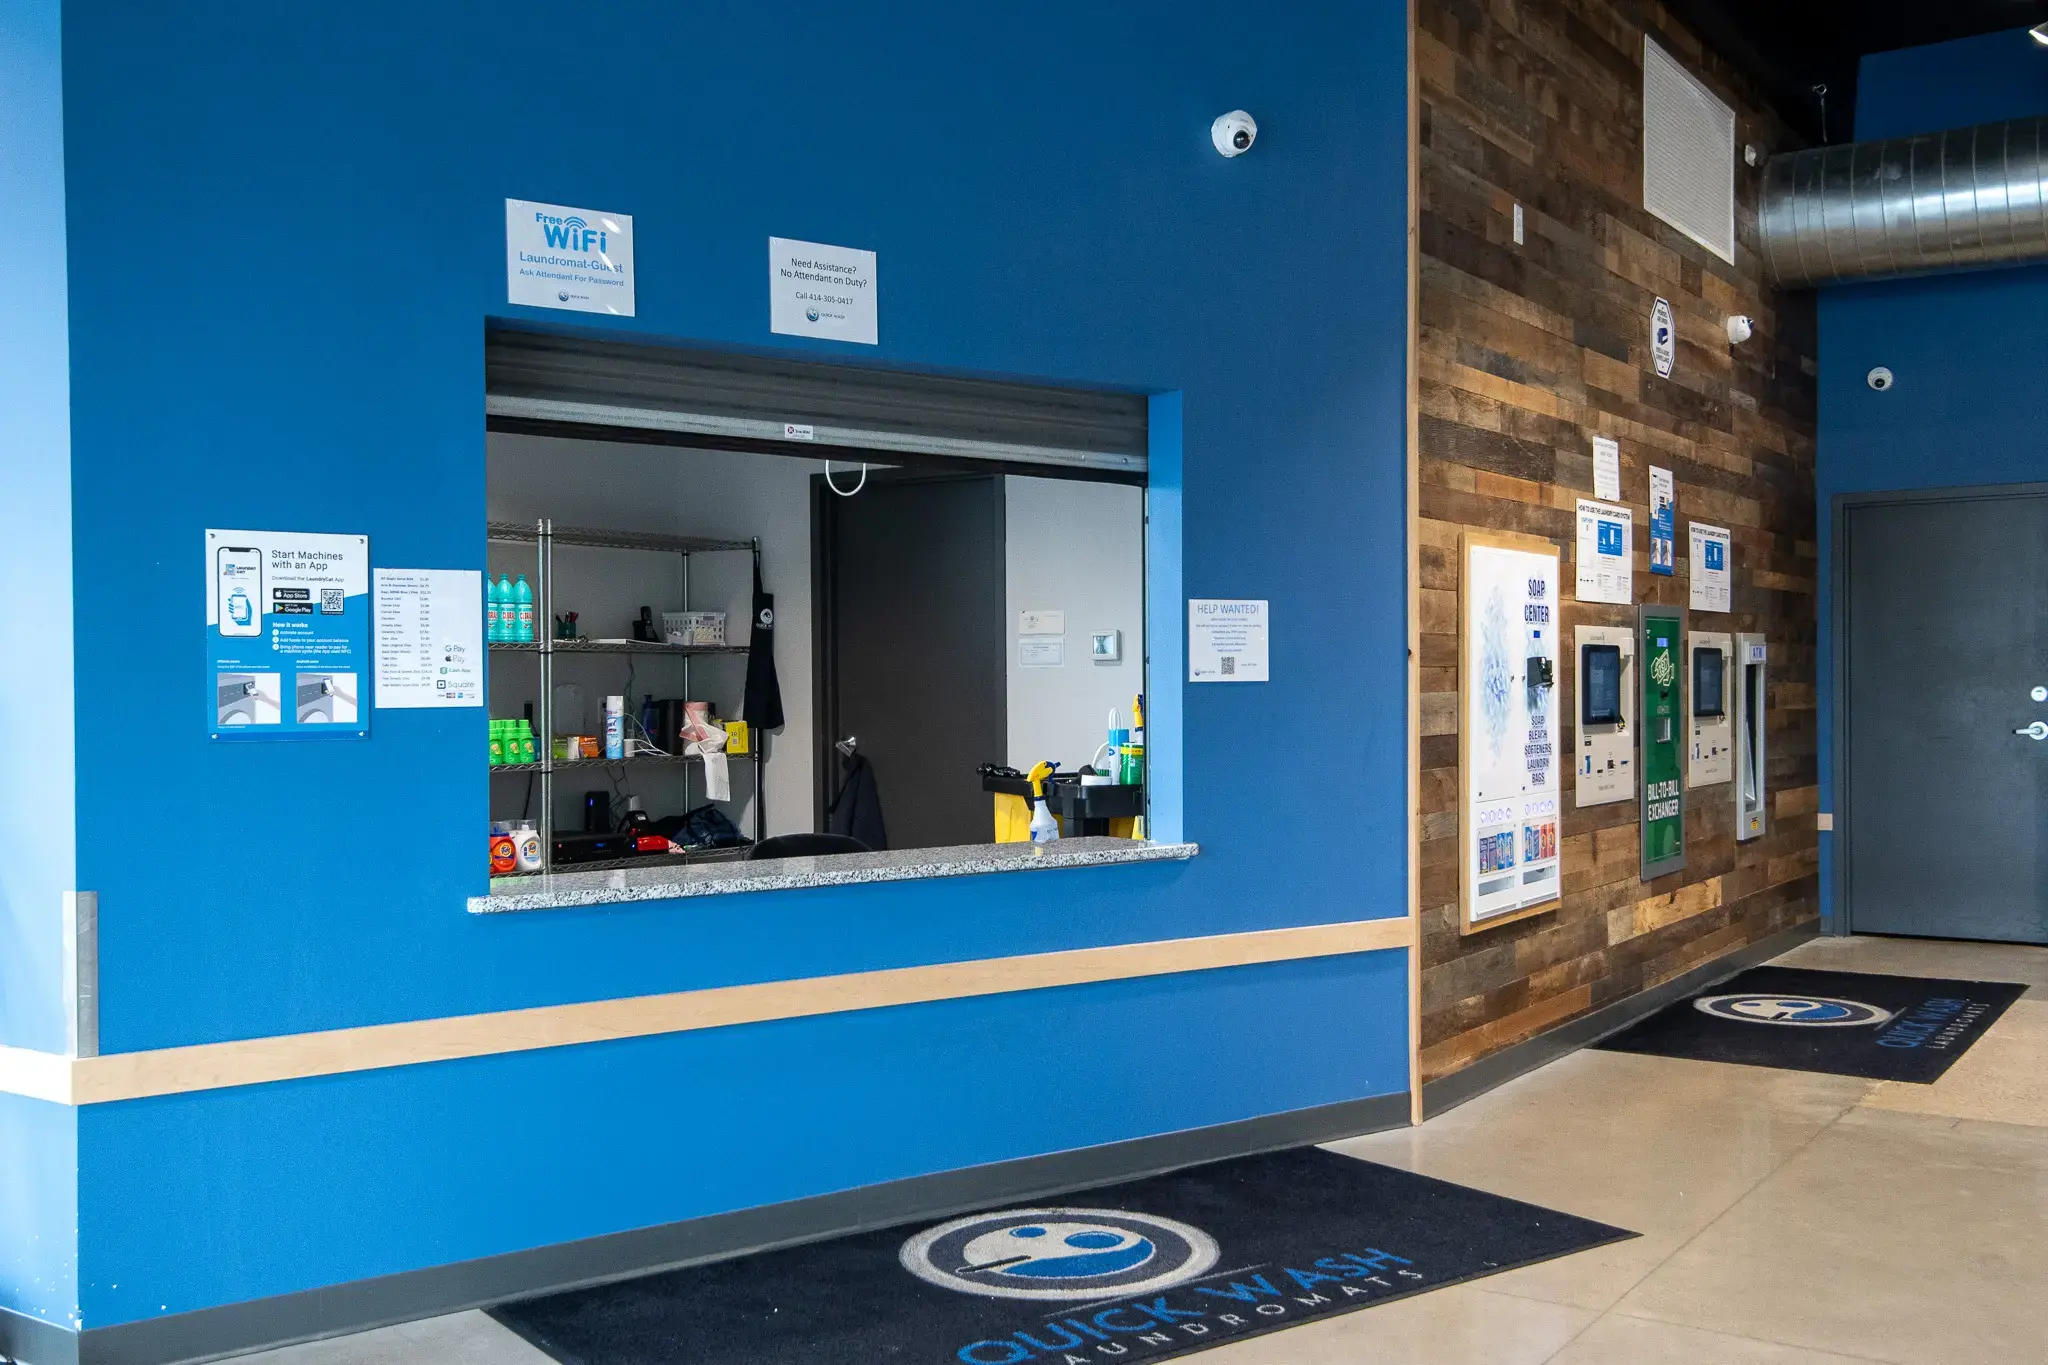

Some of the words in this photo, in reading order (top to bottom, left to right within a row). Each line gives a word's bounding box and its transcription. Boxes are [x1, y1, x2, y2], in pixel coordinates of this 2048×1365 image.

[536, 212, 562, 226] Free
[544, 224, 606, 254] WiFi
[792, 258, 812, 268] Need
[814, 262, 857, 274] Assistance?
[520, 268, 534, 276] Ask
[536, 270, 573, 281] Attendant
[588, 276, 624, 286] Password
[780, 269, 792, 278] No
[794, 270, 831, 283] Attendant
[846, 277, 867, 288] Duty?
[796, 292, 807, 300] Call
[809, 294, 853, 305] 414-305-0417
[272, 550, 295, 559] Start
[298, 551, 343, 560] Machines
[272, 561, 292, 569] with
[308, 561, 328, 572] App
[1528, 579, 1545, 596] SOAP
[1198, 604, 1218, 614] HELP
[1220, 604, 1259, 614] WANTED!
[1525, 605, 1549, 622] CENTER
[454, 645, 465, 653] Pay
[453, 655, 465, 664] Pay
[1532, 716, 1545, 726] SOAP
[1529, 730, 1547, 740] BLEACH
[1525, 743, 1551, 755] SOFTENERS
[1528, 758, 1549, 769] LAUNDRY
[1532, 772, 1545, 783] BAGS
[1648, 780, 1679, 801] BILL-TO-BILL
[1648, 799, 1678, 821] EXCHANGER
[1876, 1020, 1942, 1048] QUICK
[957, 1297, 1204, 1365] QUICK
[1194, 1248, 1412, 1302] WASH
[1064, 1269, 1423, 1365] AUNDROMATS
